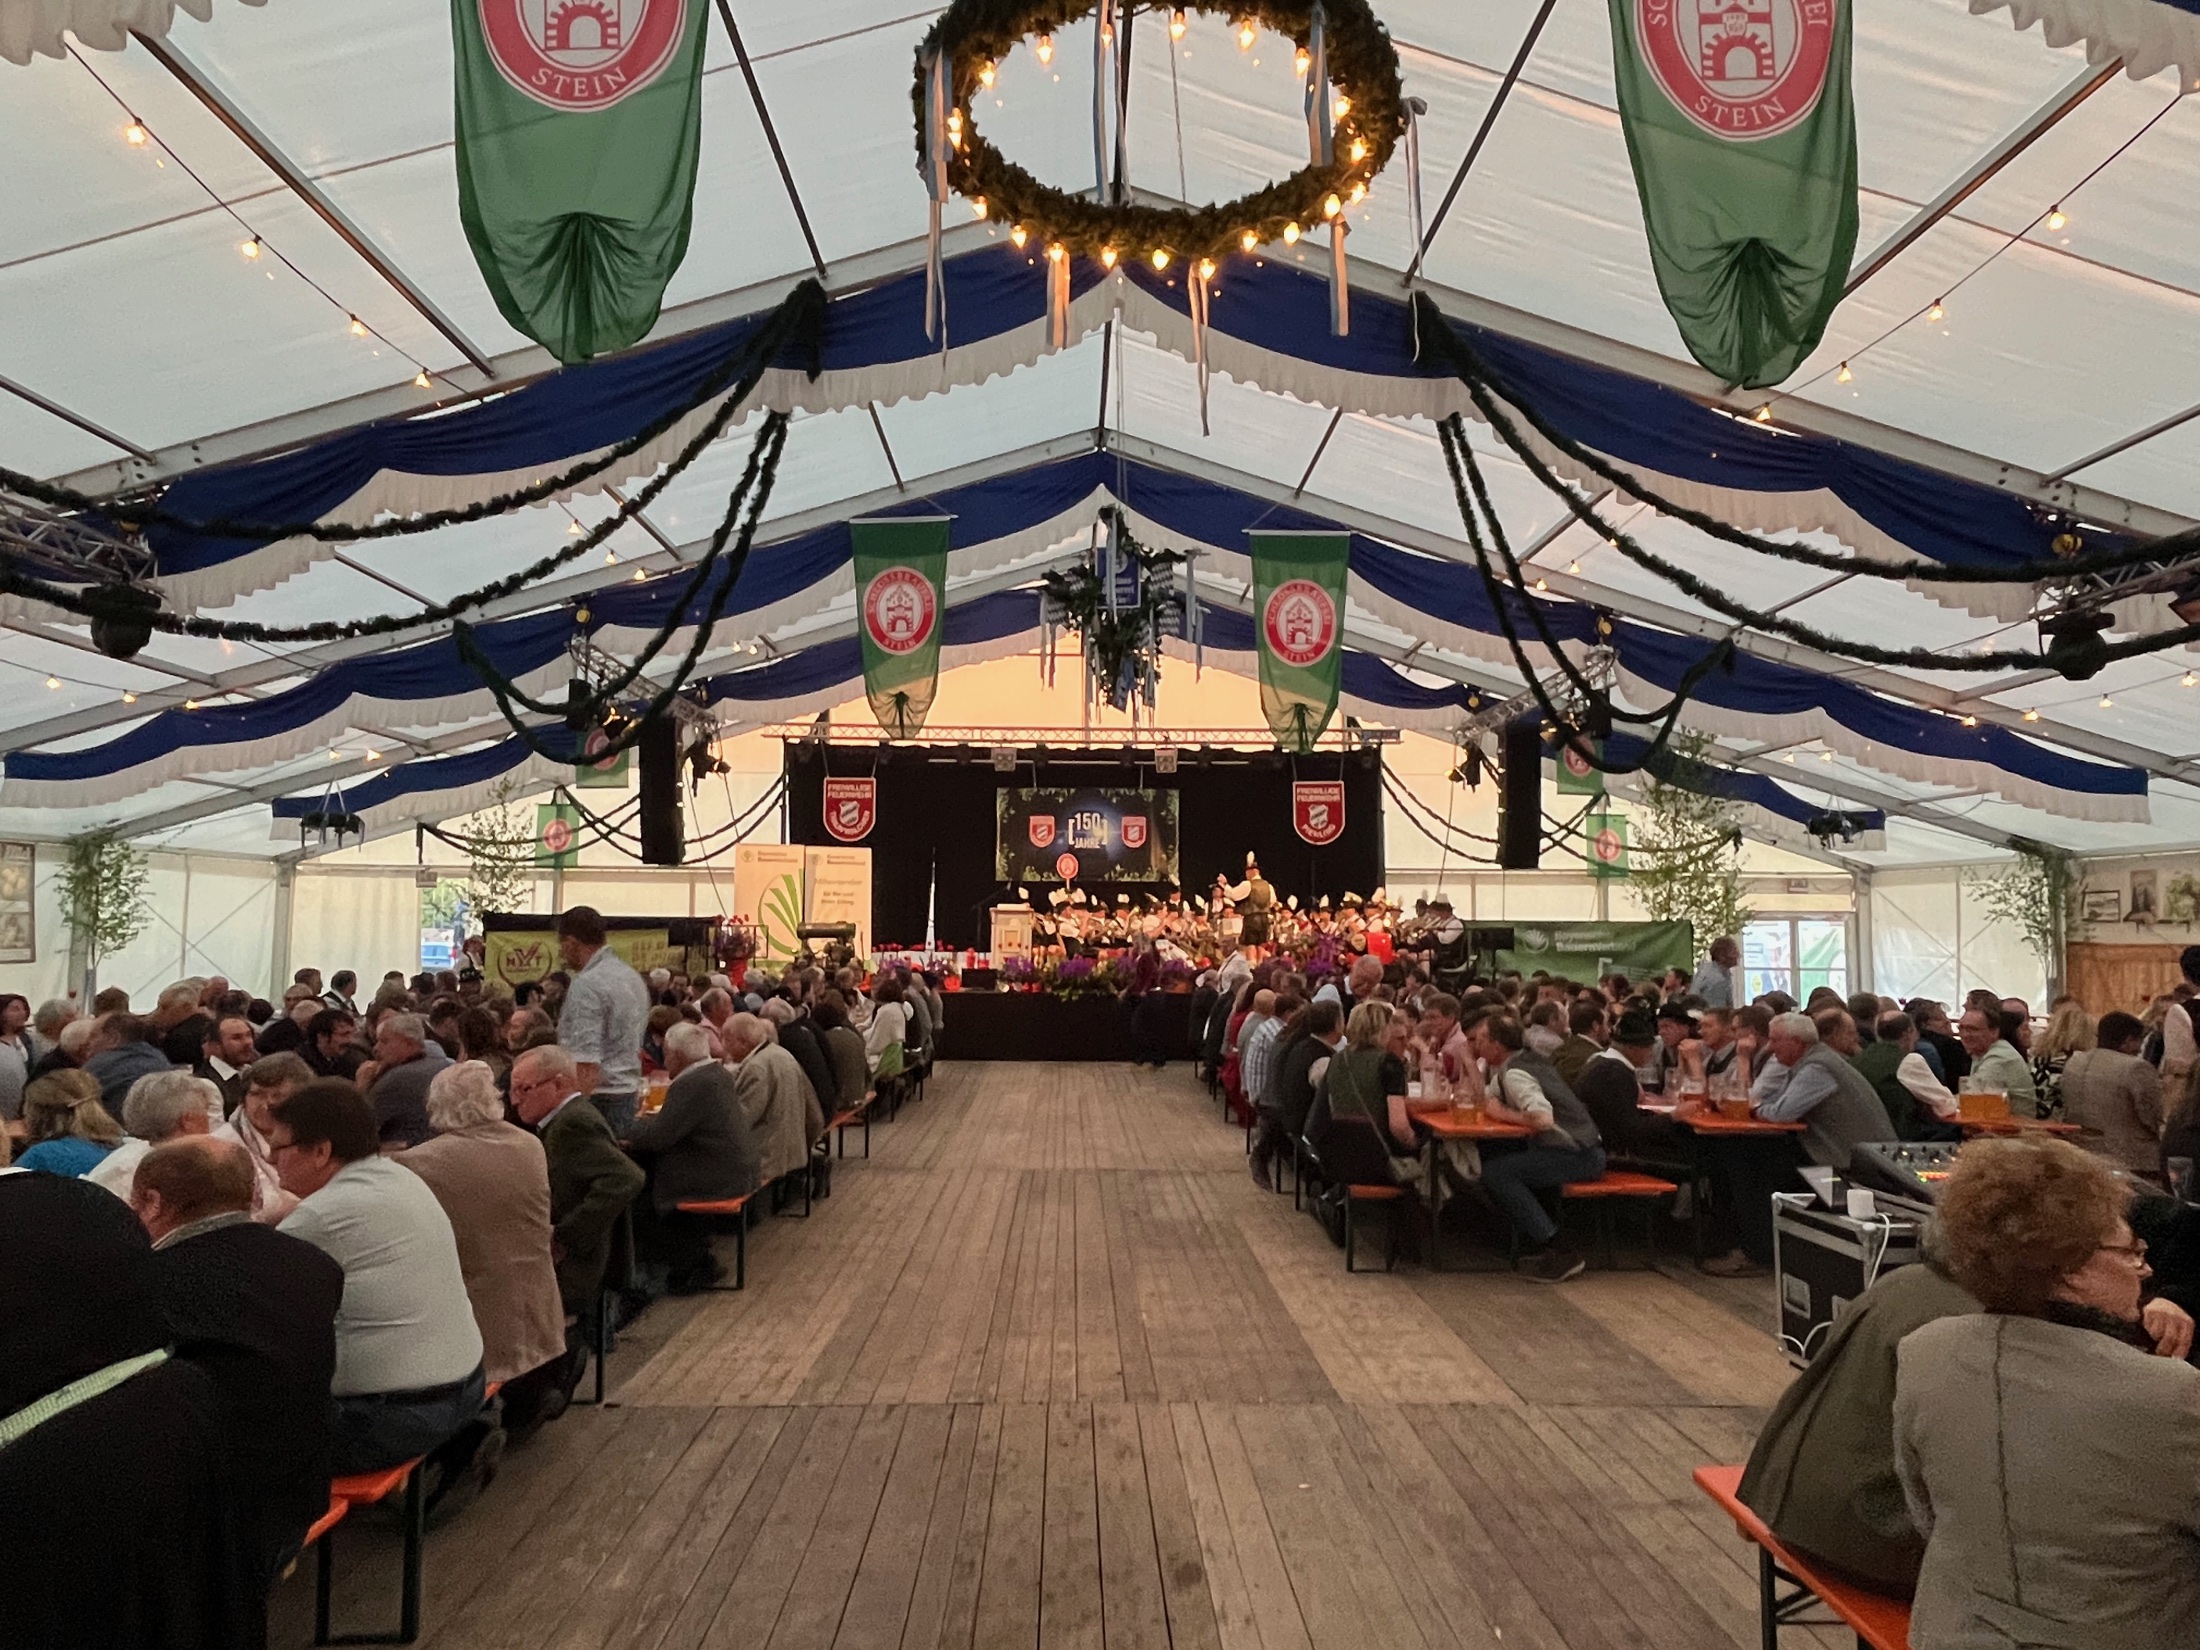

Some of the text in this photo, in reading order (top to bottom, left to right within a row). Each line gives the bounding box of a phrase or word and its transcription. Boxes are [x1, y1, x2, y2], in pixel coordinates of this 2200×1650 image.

[531, 66, 627, 98] STEIN
[1694, 95, 1786, 128] STEIN
[883, 638, 917, 651] STEIN
[1283, 650, 1316, 663] STEIN
[1074, 812, 1101, 831] 150
[1074, 837, 1101, 849] JAHRE
